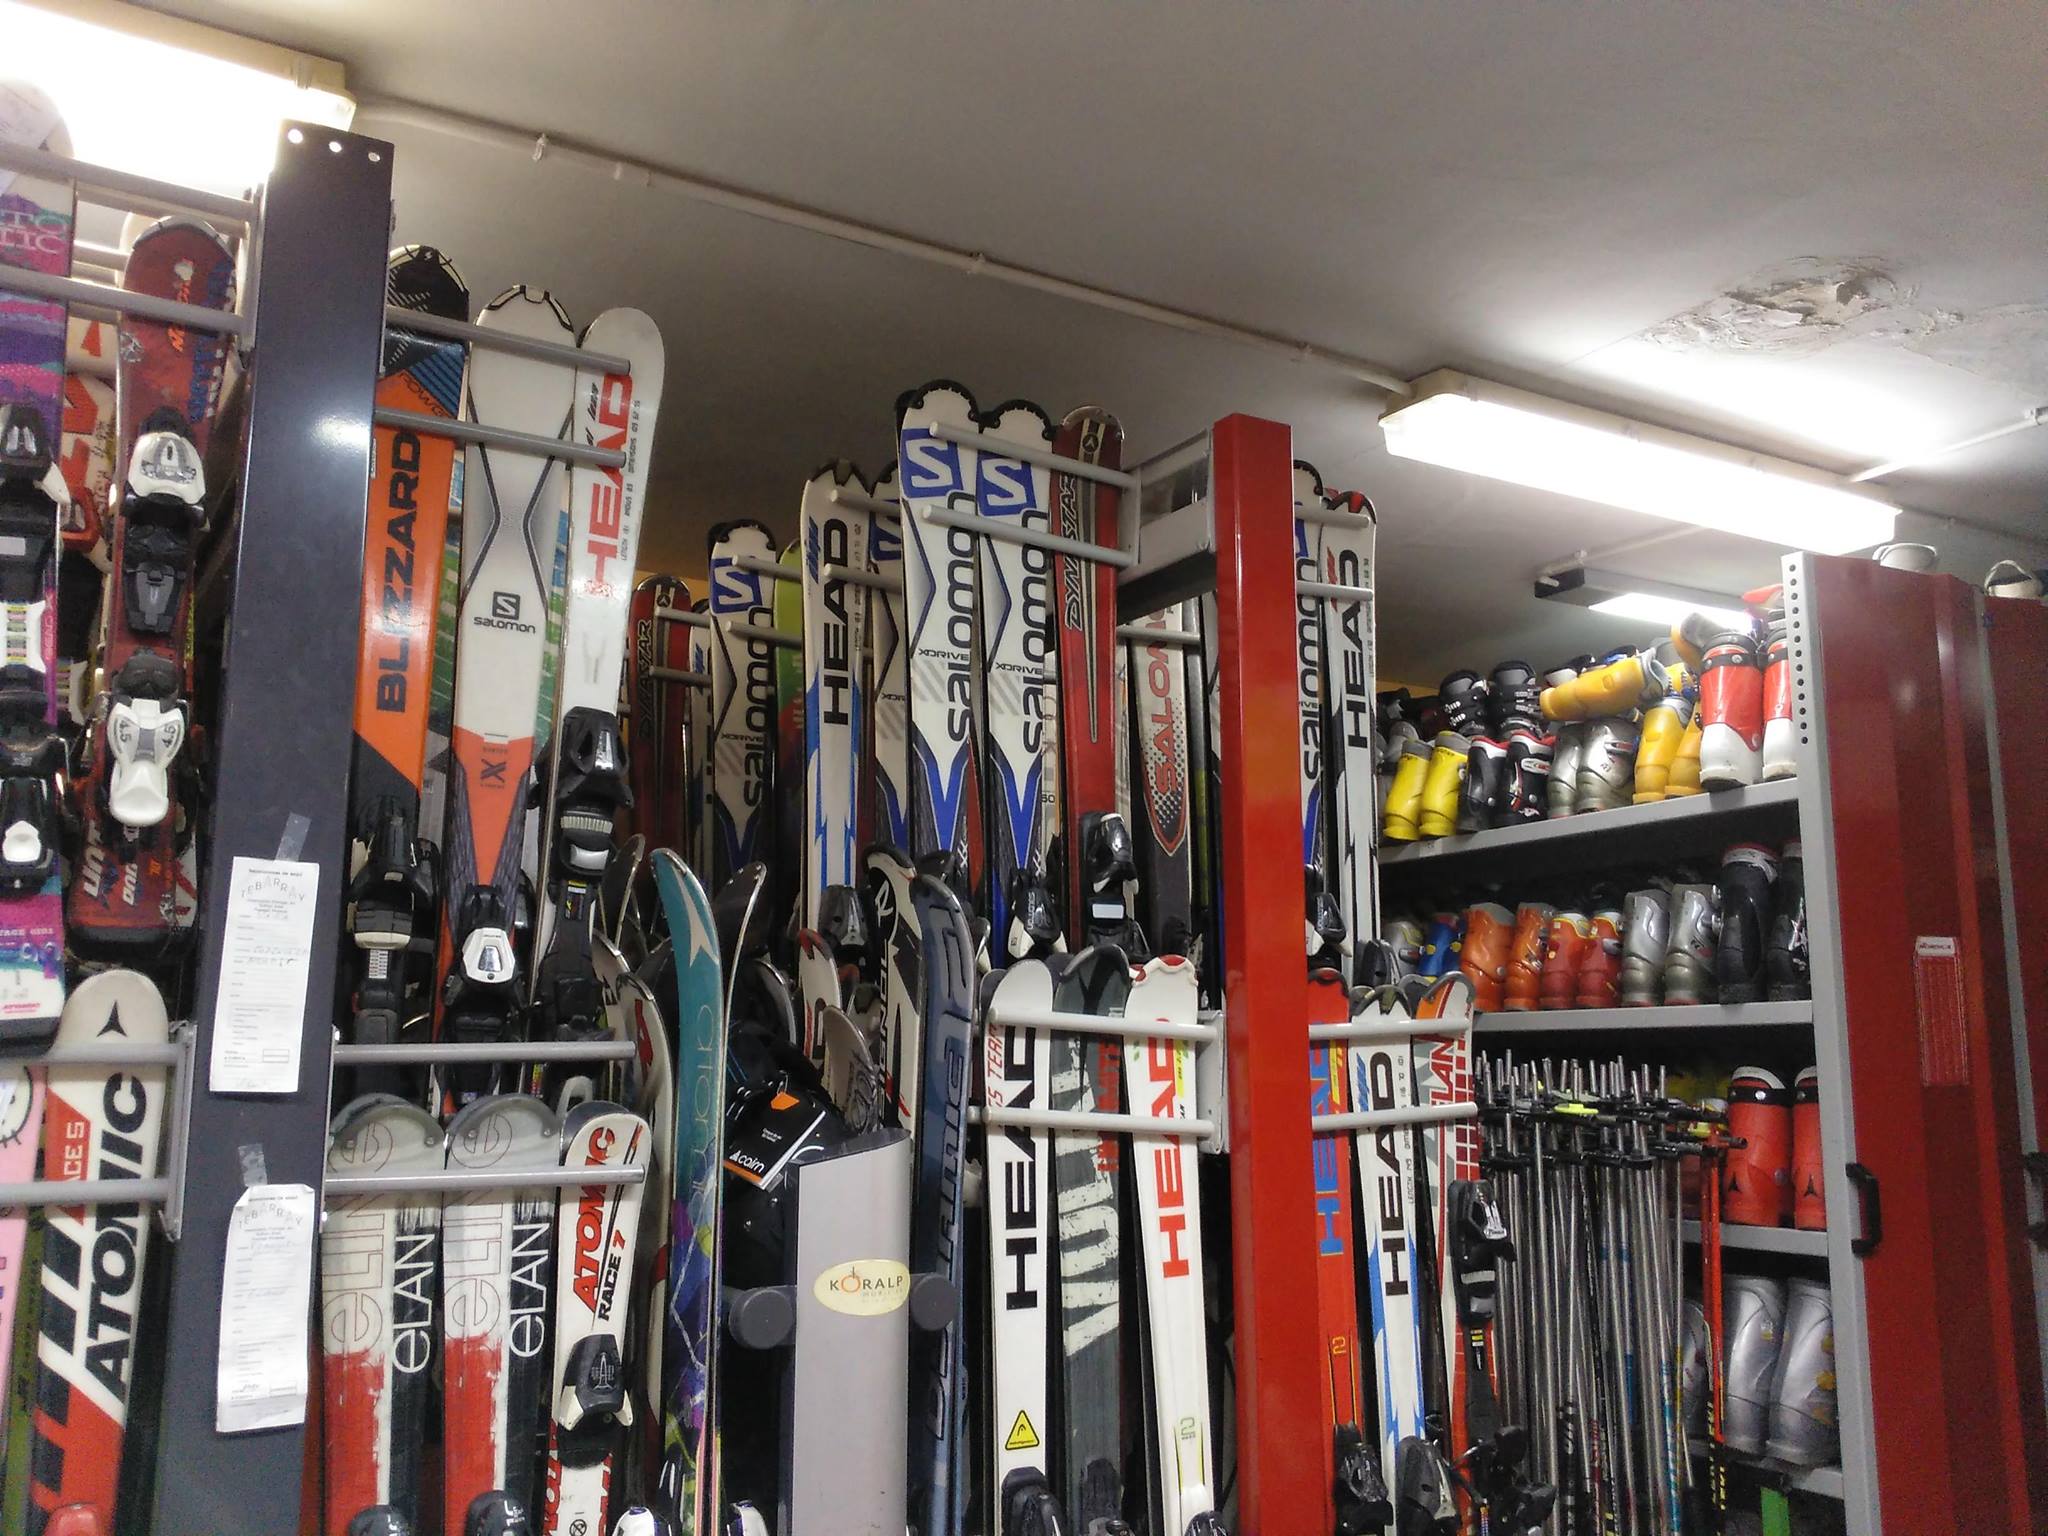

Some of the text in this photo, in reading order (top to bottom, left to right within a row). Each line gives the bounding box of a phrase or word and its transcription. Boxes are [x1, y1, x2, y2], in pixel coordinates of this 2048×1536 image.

[376, 431, 421, 713] BLIZZARD
[585, 374, 633, 597] HEAD
[473, 616, 537, 634] salomon
[823, 518, 849, 726] HEAD
[918, 647, 969, 662] XDRIVE
[995, 661, 1043, 676] XDRIVE
[1339, 549, 1369, 749] HEAD
[738, 1154, 765, 1173] cairn
[1004, 1022, 1038, 1311] HEAD
[1149, 1018, 1190, 1279] HEAD
[1308, 1021, 1344, 1256] HEAD
[1370, 1052, 1409, 1297] HEAD
[597, 1229, 627, 1321] RACE 7
[829, 1274, 904, 1293] KORALP
